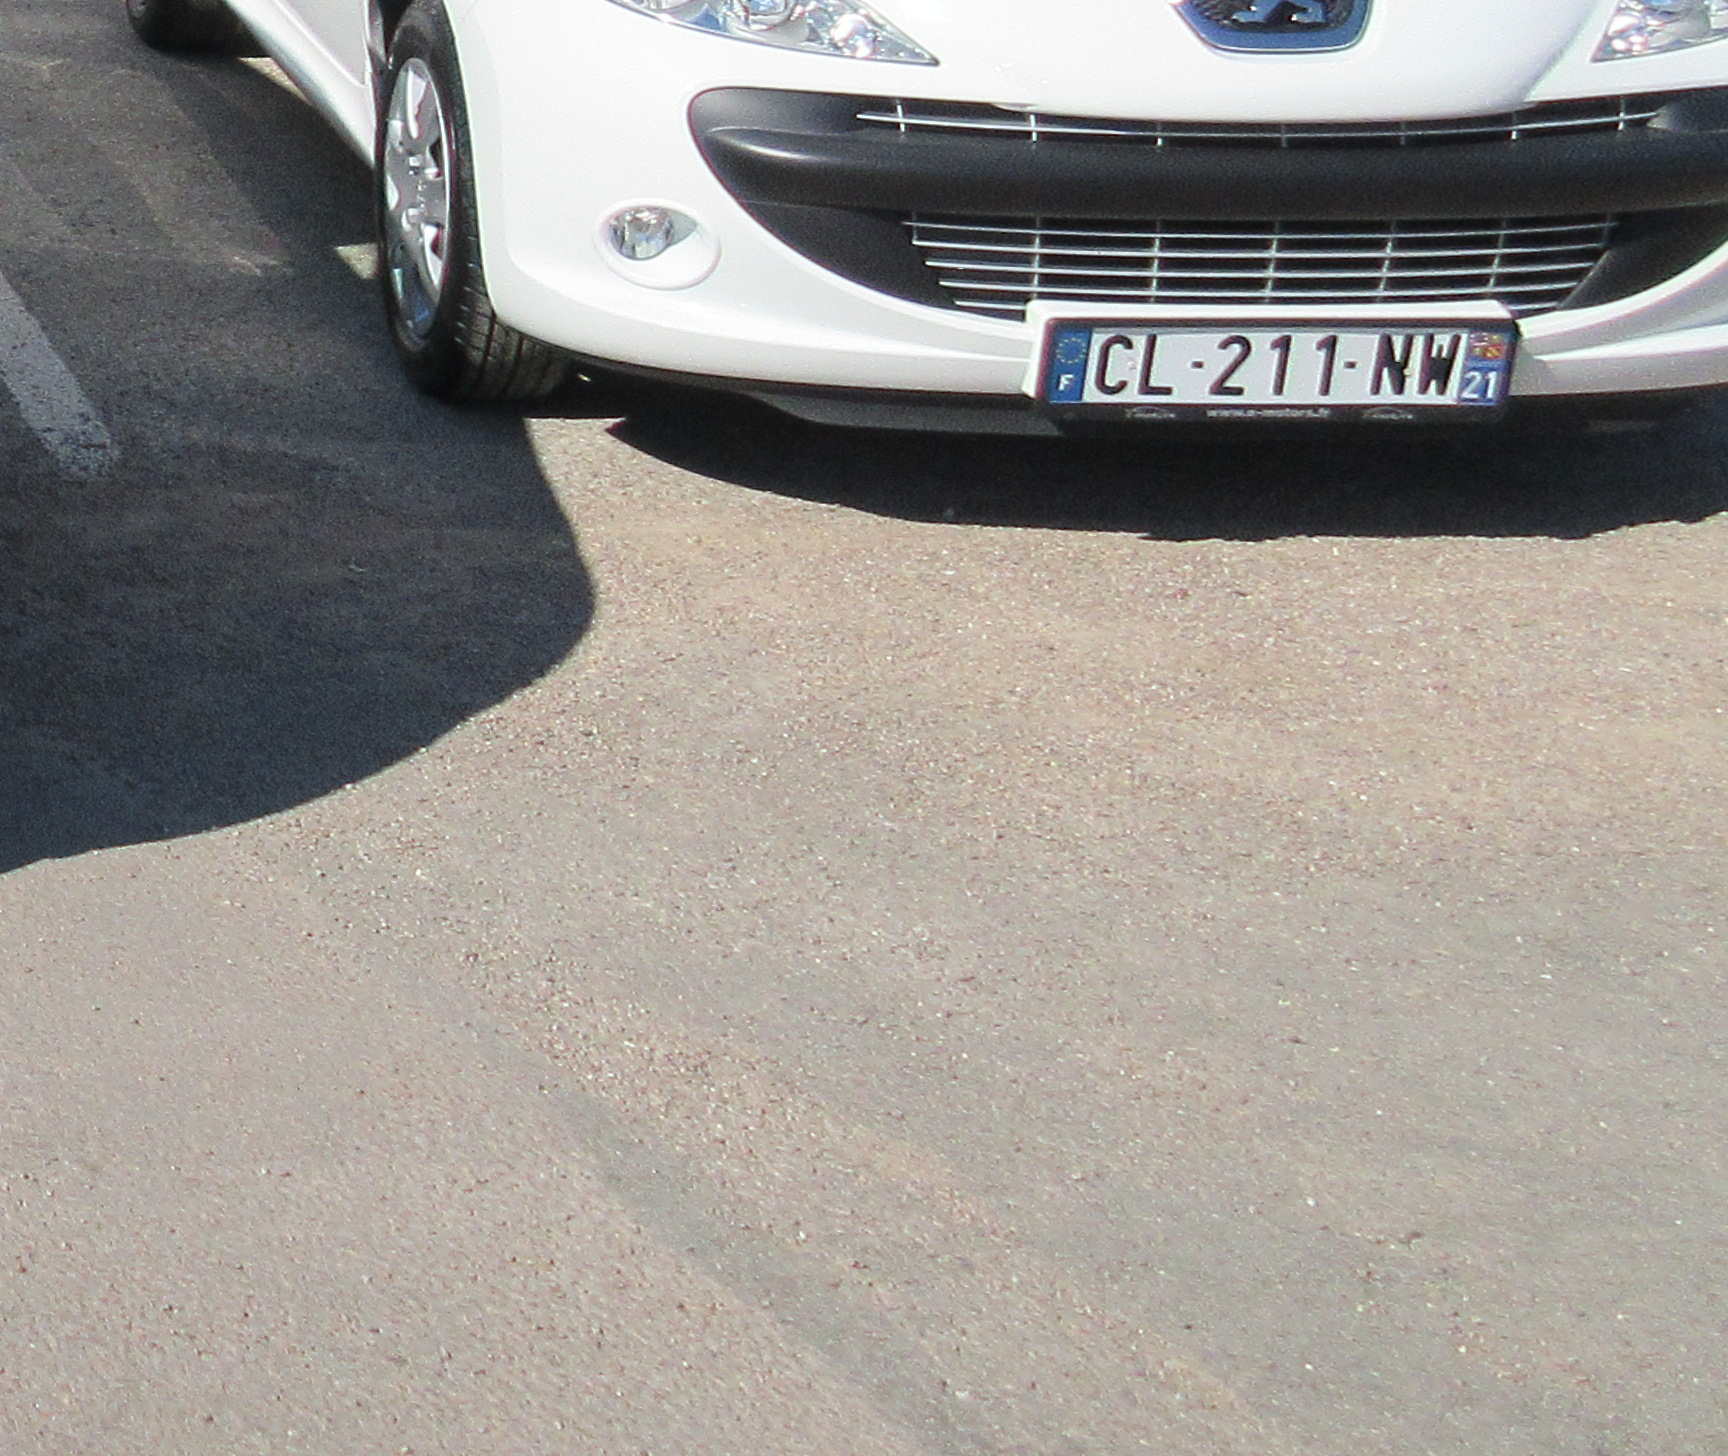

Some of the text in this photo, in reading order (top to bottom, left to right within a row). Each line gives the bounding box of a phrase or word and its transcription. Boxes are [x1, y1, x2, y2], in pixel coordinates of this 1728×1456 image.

[1094, 332, 1461, 397] CL-211-NW
[1056, 373, 1074, 391] F
[1461, 371, 1498, 398] 21
